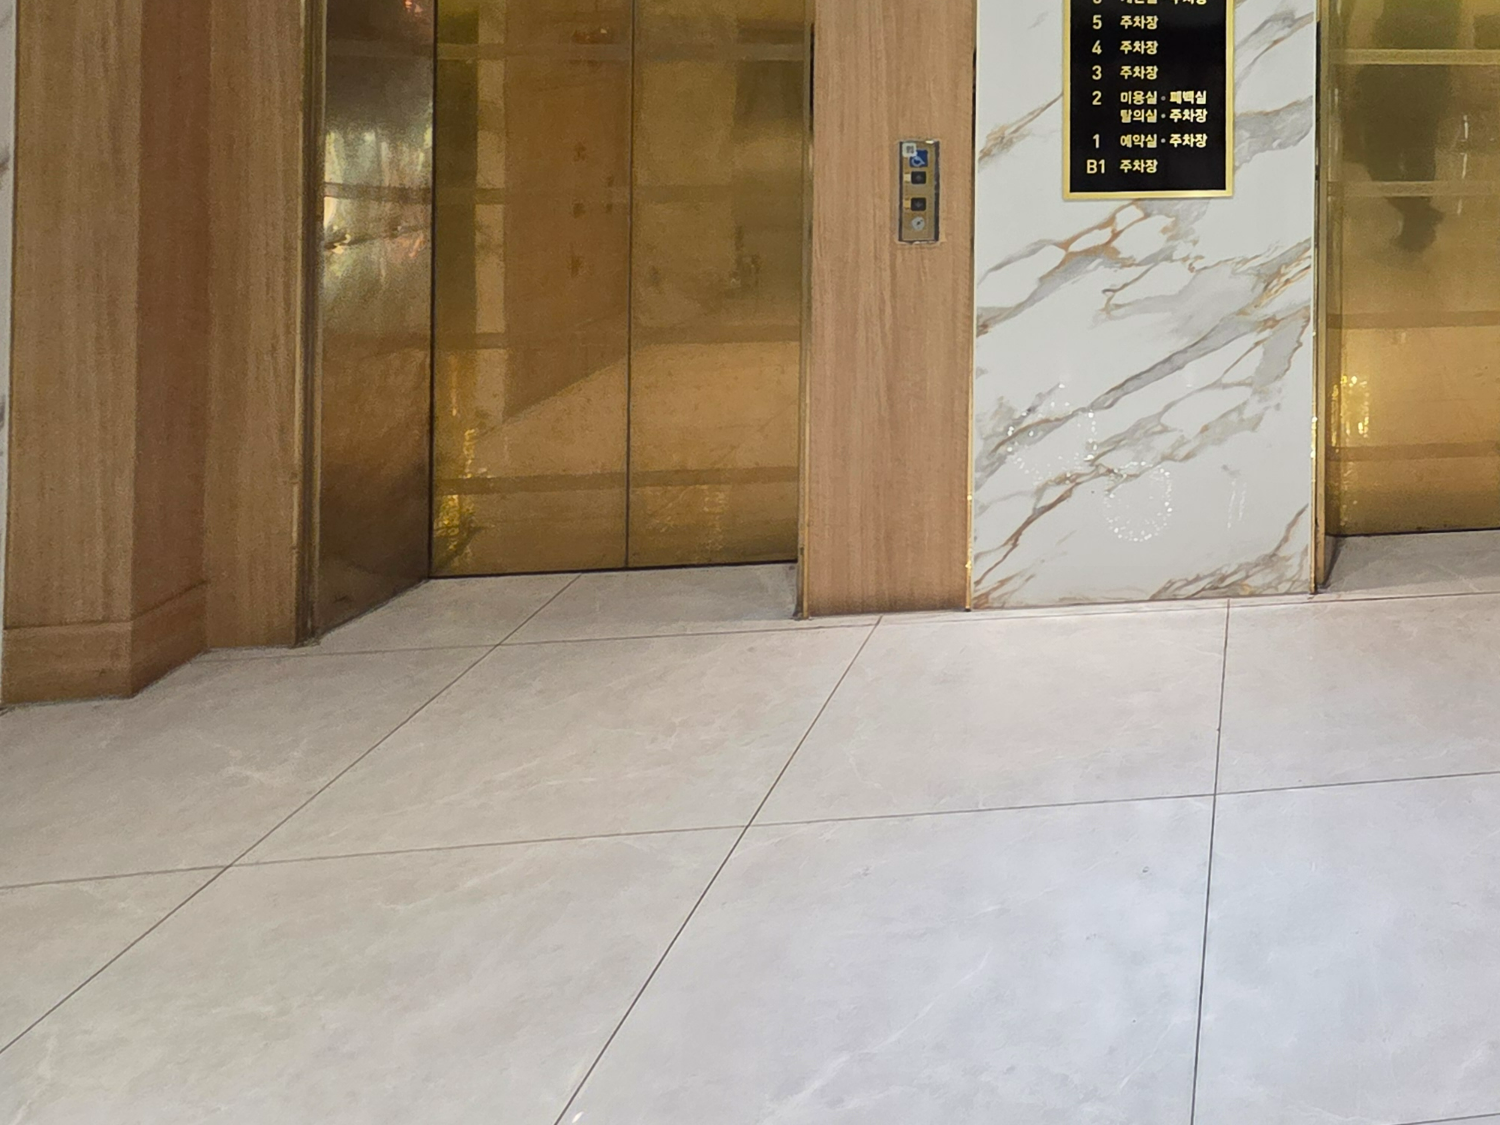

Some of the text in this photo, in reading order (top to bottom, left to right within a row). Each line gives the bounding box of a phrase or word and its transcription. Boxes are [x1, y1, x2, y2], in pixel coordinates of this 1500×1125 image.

[1092, 14, 1159, 30] 5 주차장
[1091, 39, 1159, 55] 4 주차장
[1092, 65, 1159, 81] 3 주차장
[1092, 90, 1102, 106] 2
[1120, 90, 1158, 106] 미용실
[1169, 108, 1208, 124] 주차장
[1092, 133, 1208, 149] 1 예약실 주차장
[1086, 159, 1158, 174] B1 주차장
